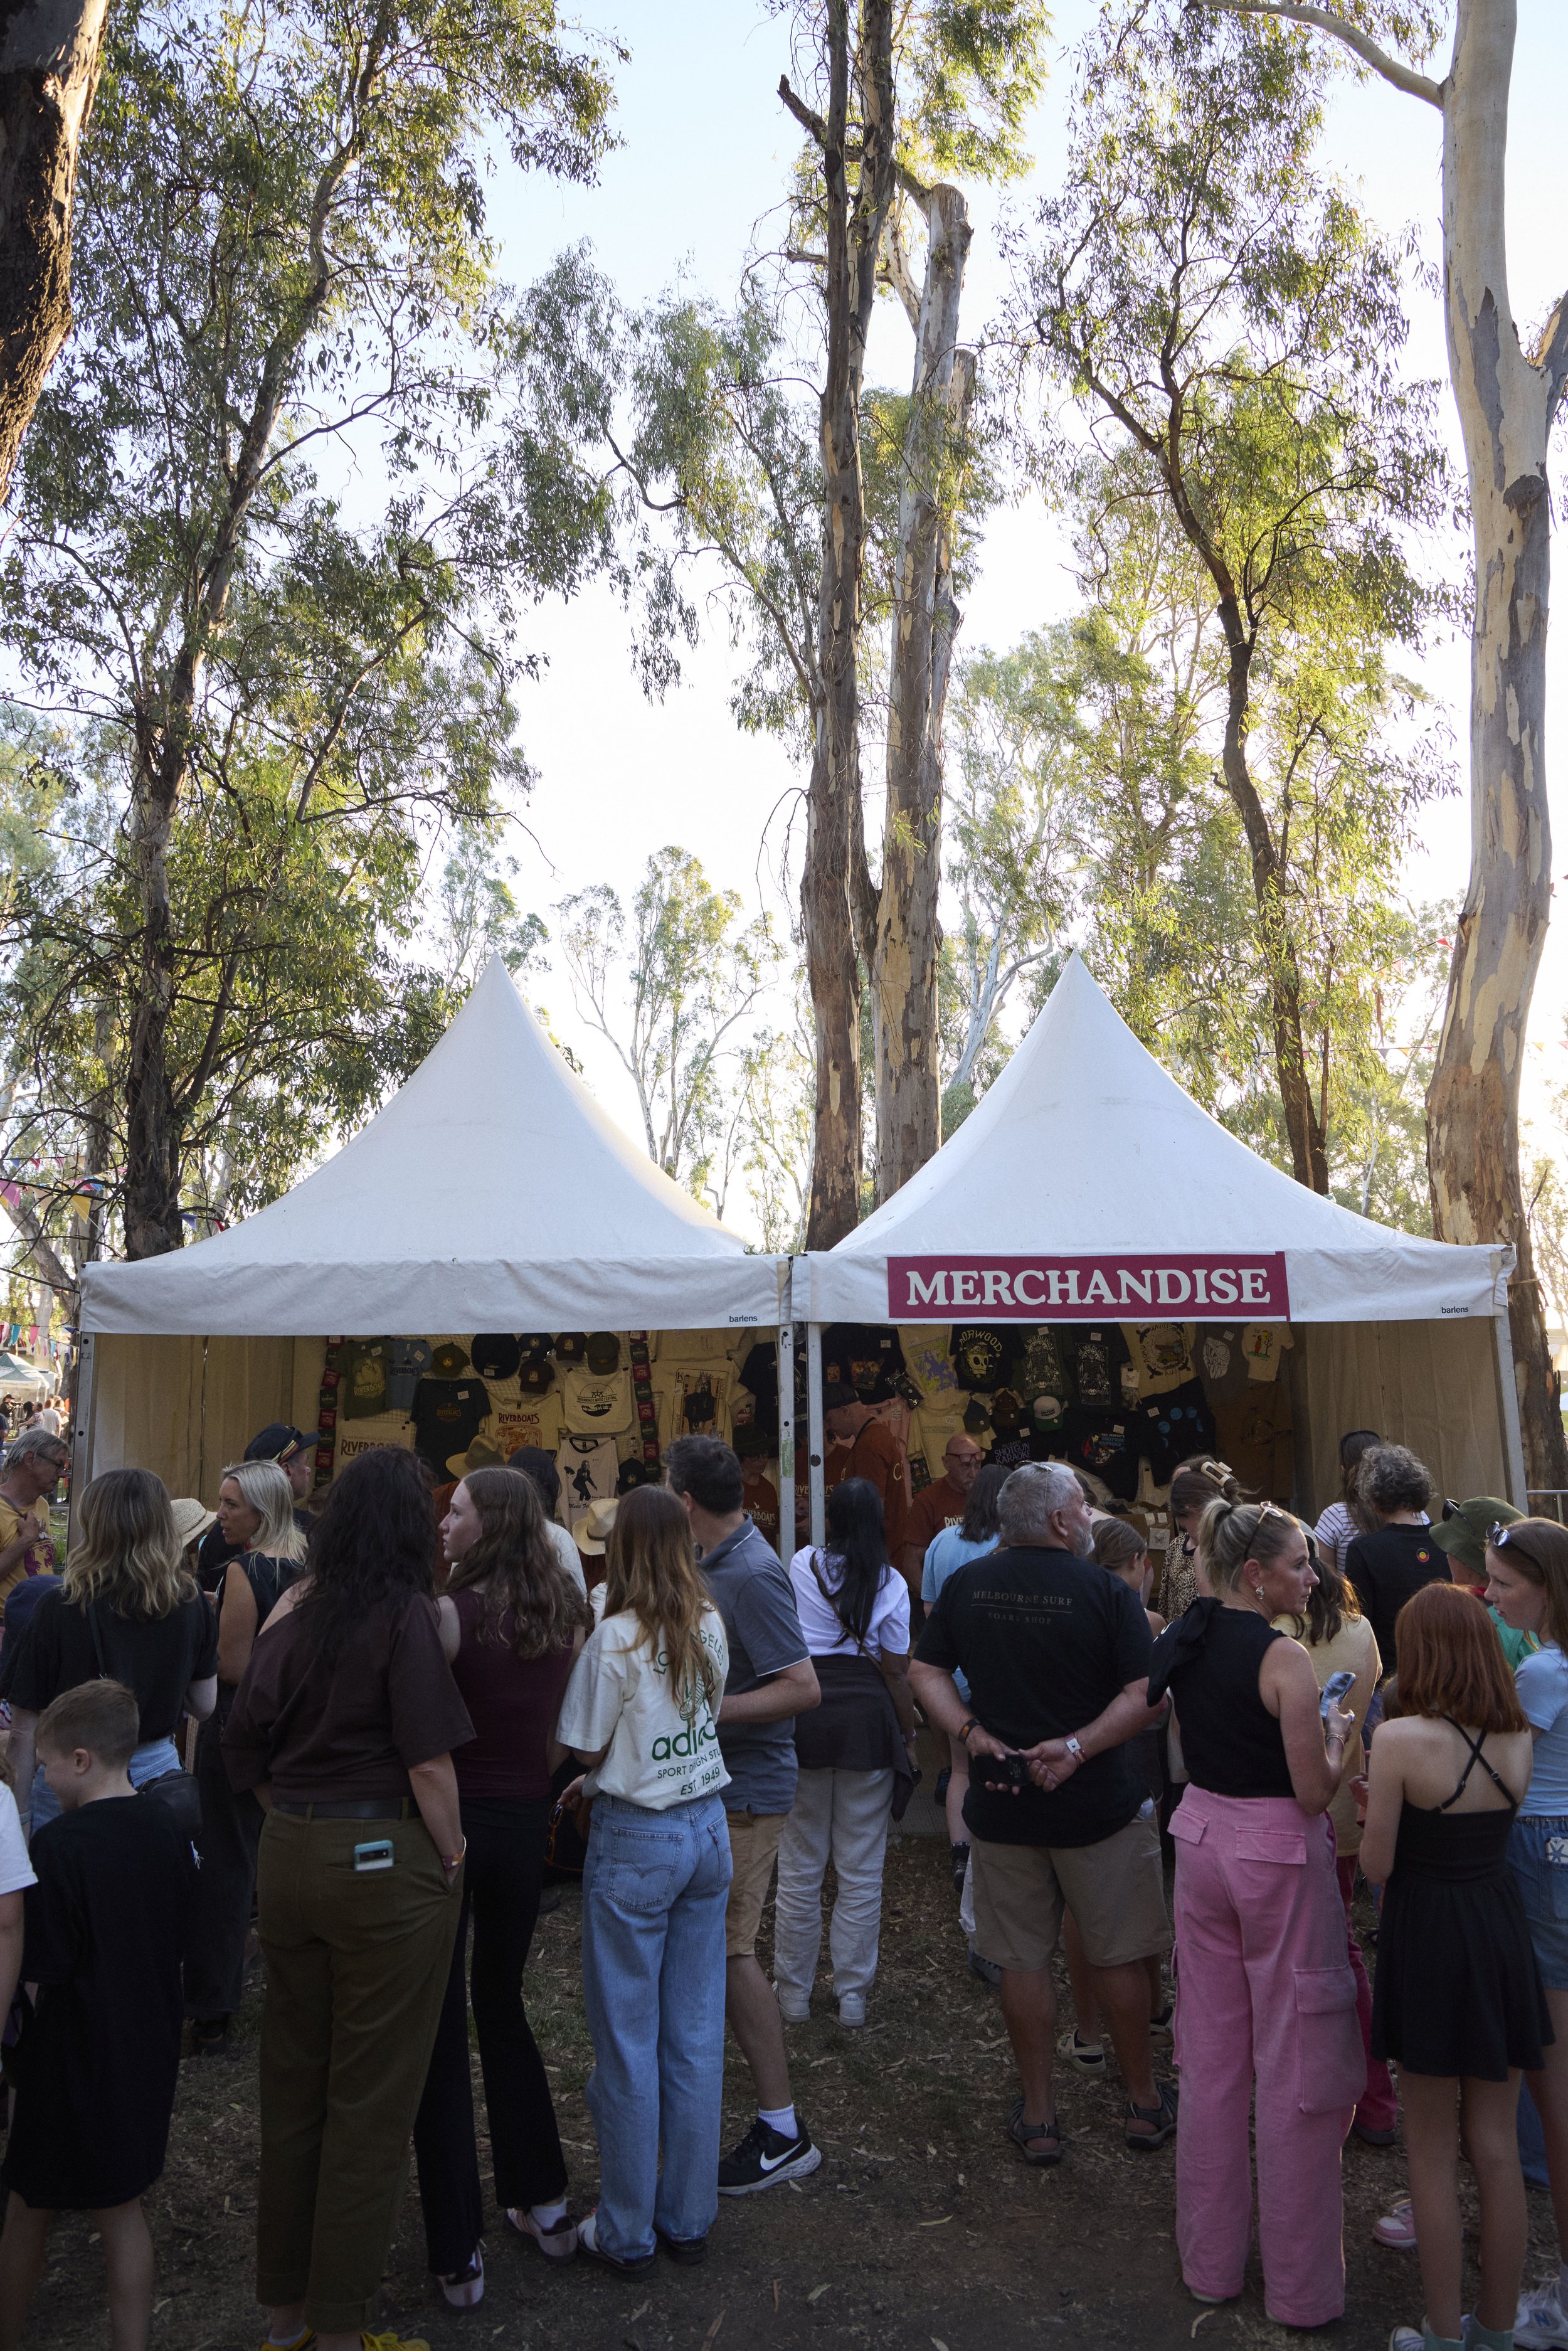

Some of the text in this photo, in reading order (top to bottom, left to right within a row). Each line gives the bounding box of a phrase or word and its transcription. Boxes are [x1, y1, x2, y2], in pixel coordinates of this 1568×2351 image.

[906, 1268, 1271, 1305] MERCHANDISE
[499, 1413, 539, 1424] RIVERBOATS
[994, 1442, 1029, 1457] SHOTGUN
[995, 1450, 1031, 1465] KARAOKE
[973, 1591, 1073, 1606] MELBOURNE SURF
[1025, 1616, 1051, 1625] SHOP
[657, 1766, 686, 1779] SPORT
[681, 1766, 720, 1795] EST. 1949
